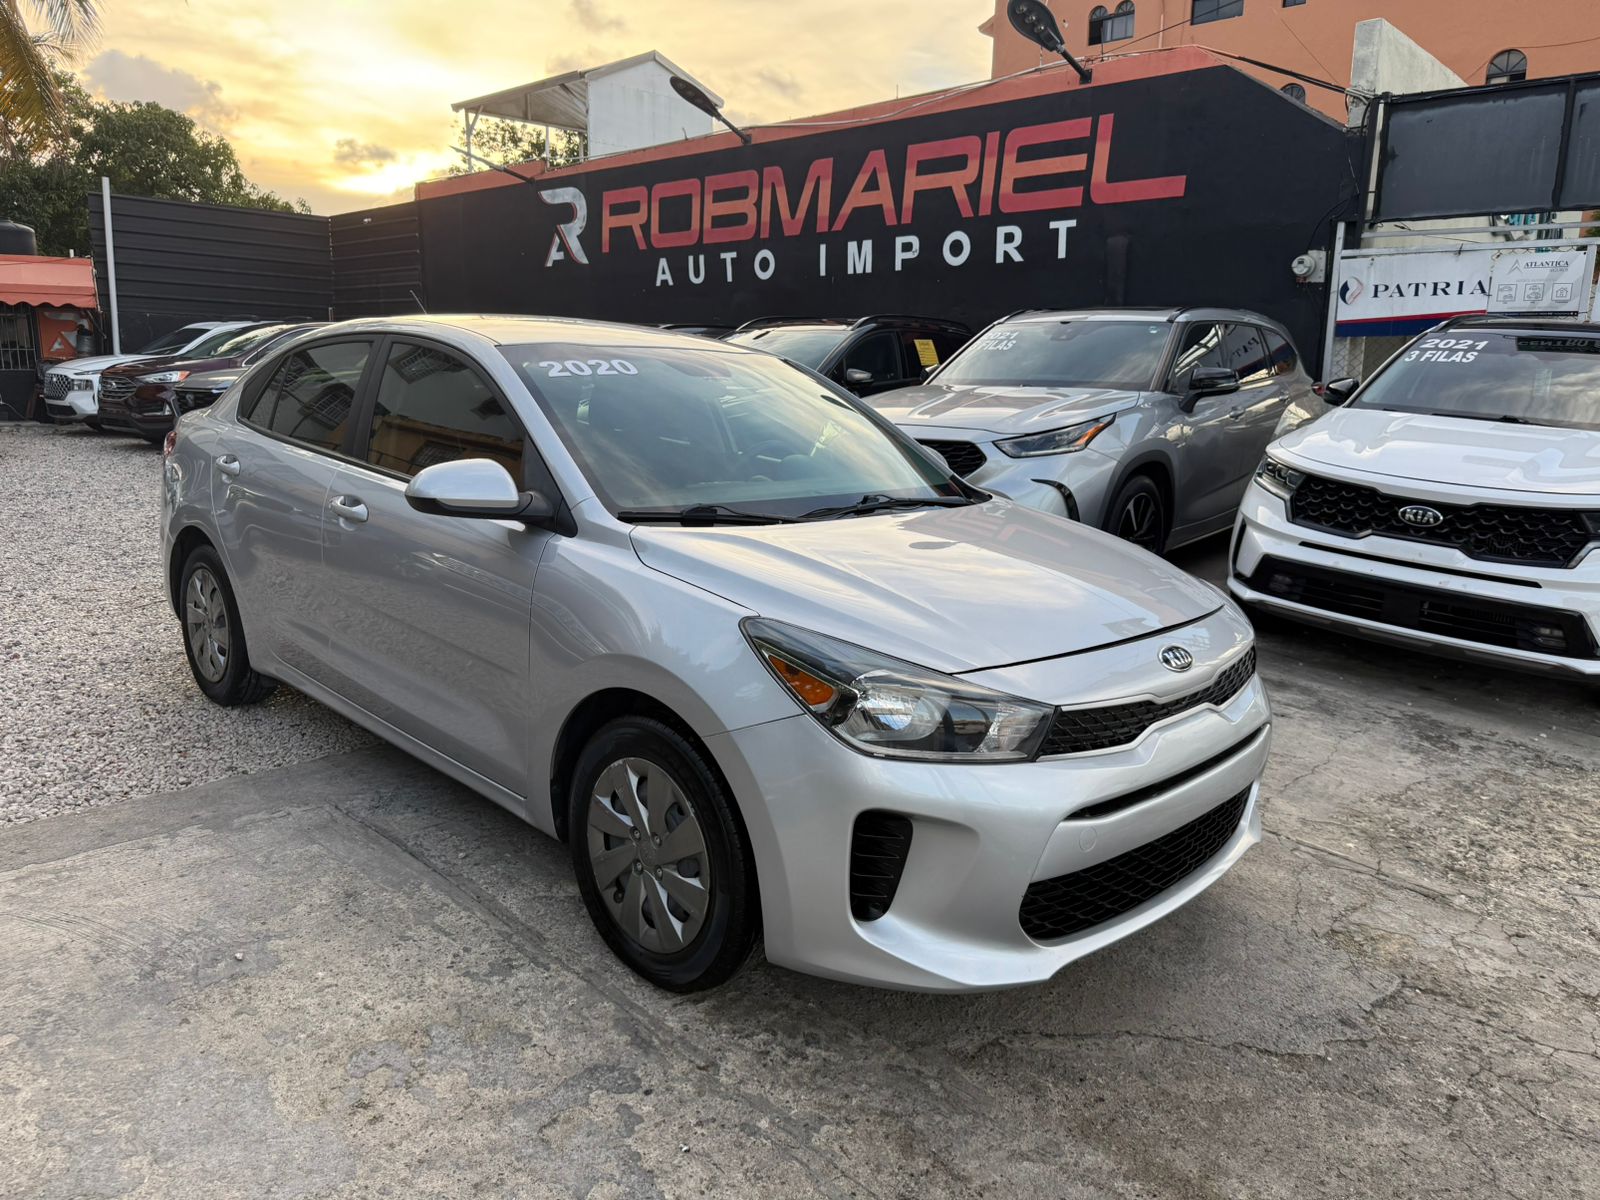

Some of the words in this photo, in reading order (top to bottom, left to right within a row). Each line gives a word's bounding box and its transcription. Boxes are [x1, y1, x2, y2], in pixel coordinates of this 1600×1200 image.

[602, 113, 1187, 254] ROBMARIEL
[655, 249, 776, 287] AUTO
[819, 219, 1077, 277] IMPORT
[1524, 260, 1569, 269] ATLANTICA
[1371, 279, 1488, 299] PATRIA
[1419, 338, 1489, 351] 2021
[1404, 350, 1420, 362] 3
[1420, 350, 1479, 363] FILAS
[538, 359, 639, 378] 2020
[1404, 508, 1435, 524] KIA
[1162, 649, 1192, 667] KIA
